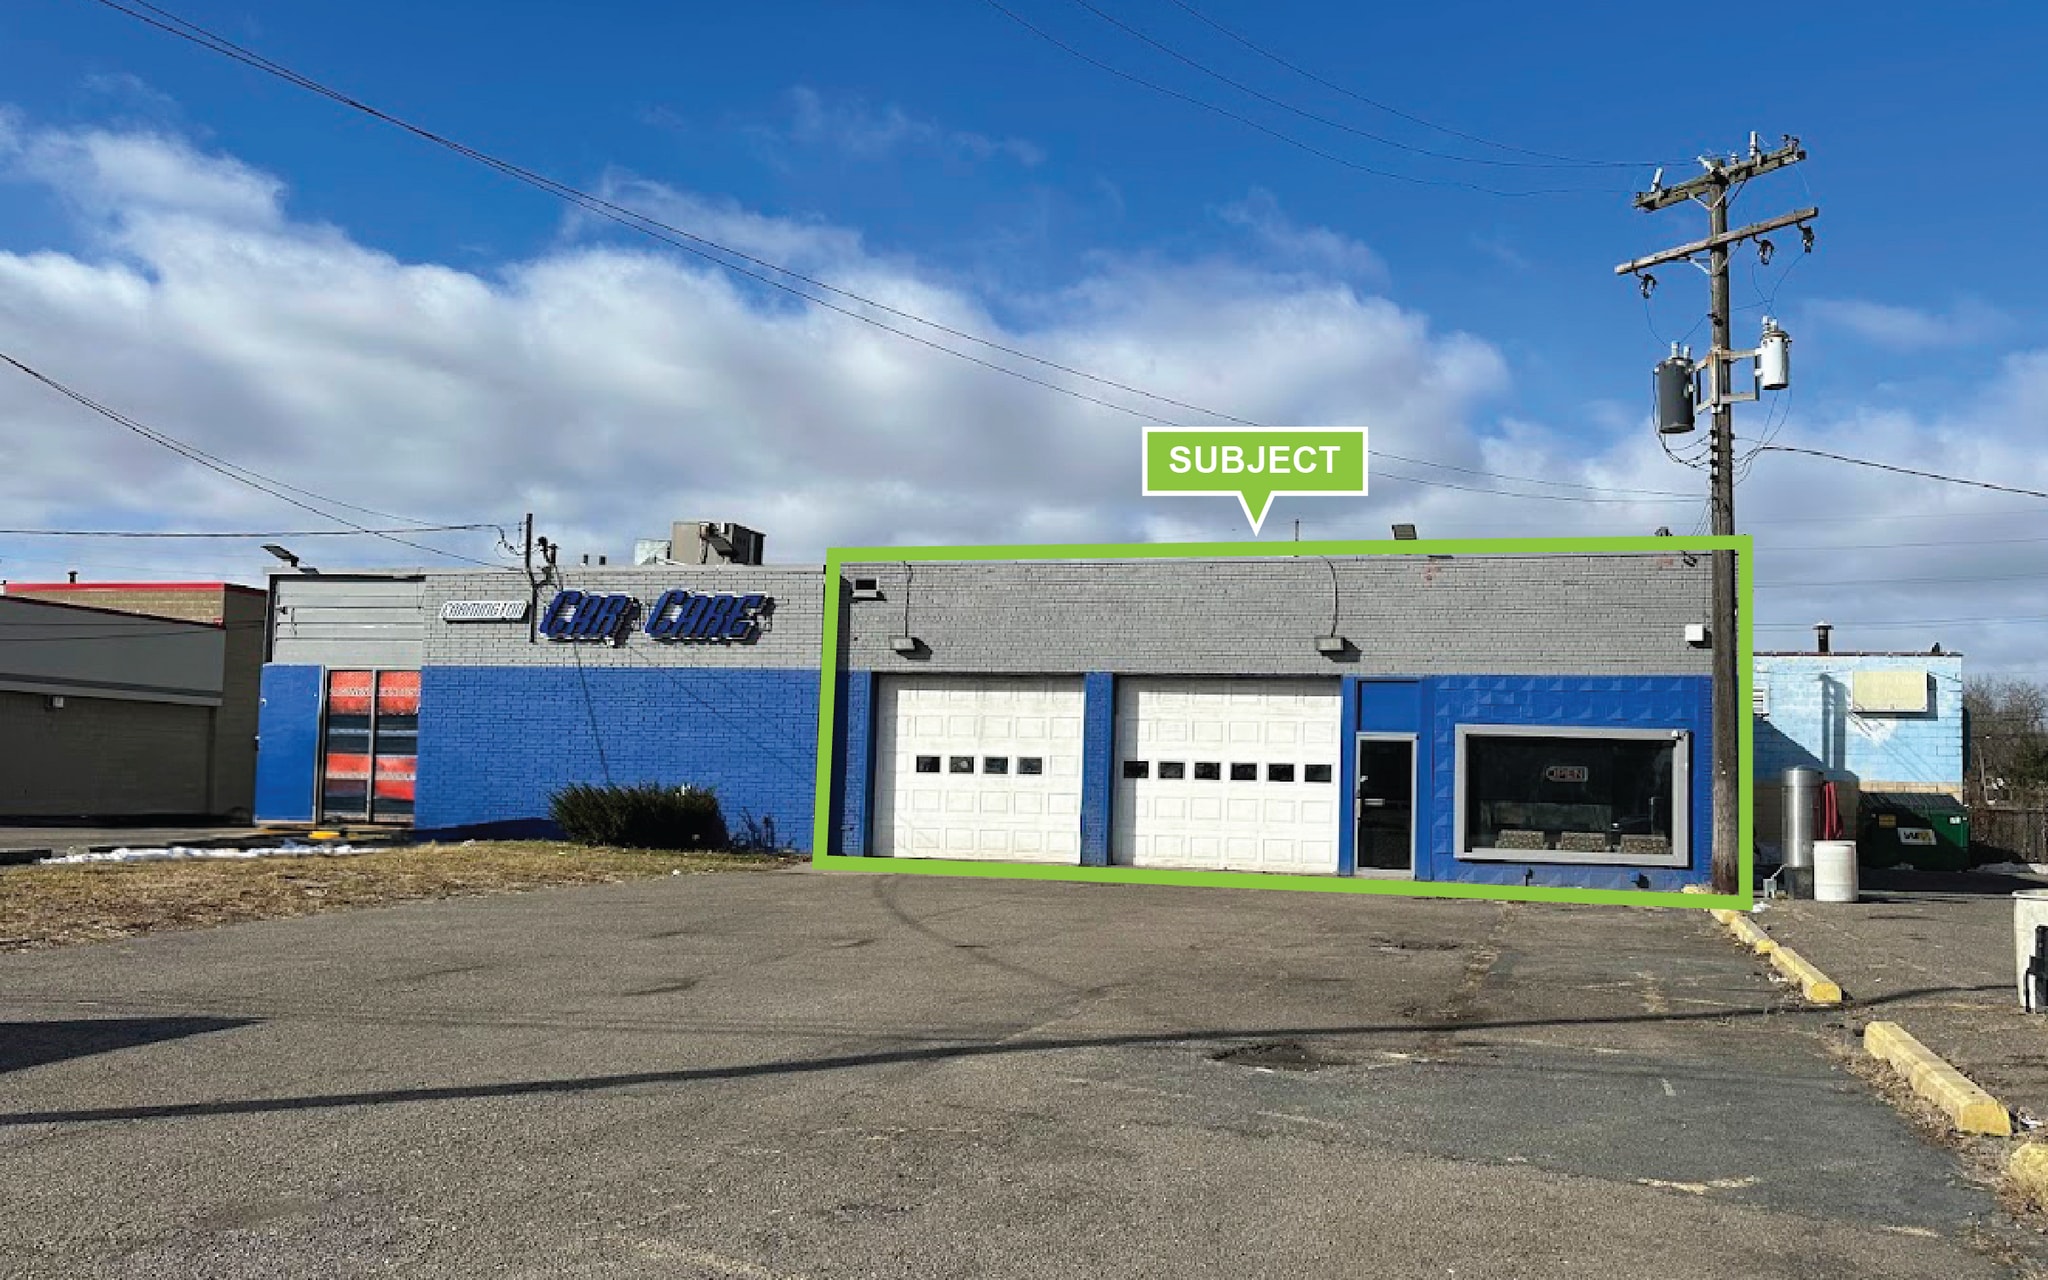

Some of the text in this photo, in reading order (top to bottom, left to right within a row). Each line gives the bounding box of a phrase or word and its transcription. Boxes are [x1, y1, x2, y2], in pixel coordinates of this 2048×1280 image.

[540, 589, 769, 641] CAR CARE
[1546, 768, 1582, 781] OPEN
